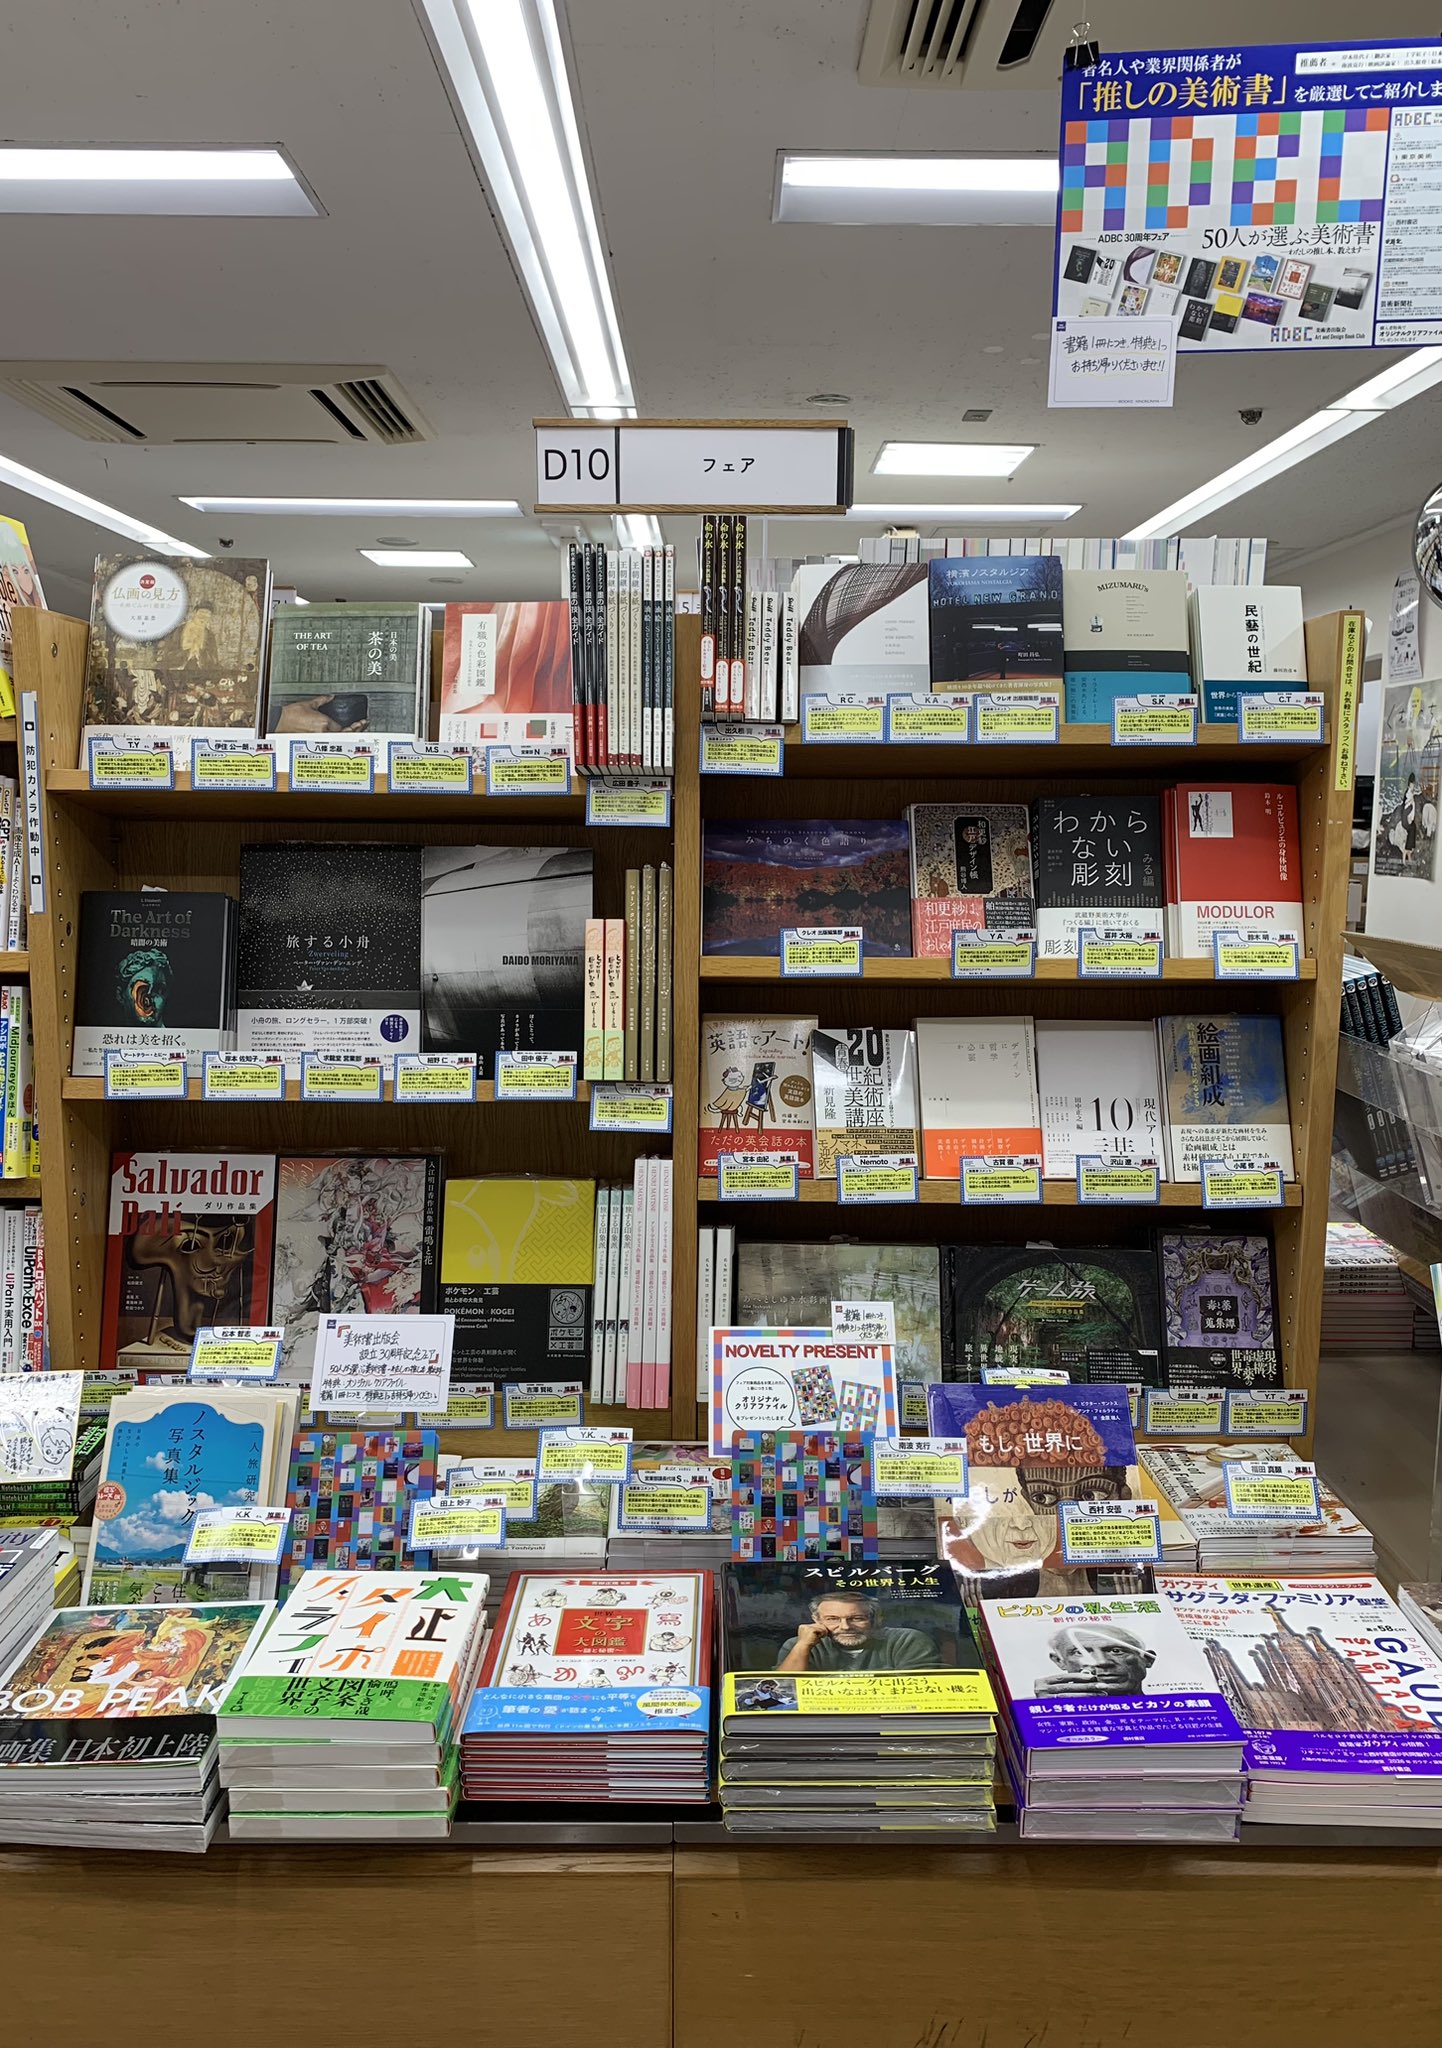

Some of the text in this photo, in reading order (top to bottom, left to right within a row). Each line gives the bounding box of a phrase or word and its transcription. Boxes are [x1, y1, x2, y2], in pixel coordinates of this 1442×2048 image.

[1077, 74, 1287, 112] 「推しの美術書」
[1098, 232, 1170, 243] ADBC 30周年フェア
[1202, 222, 1376, 249] 50人が選ぶ美術書
[1271, 327, 1313, 342] ADBC
[544, 448, 610, 480] D10
[703, 457, 756, 474] フェア
[704, 522, 713, 549] 命の水
[720, 522, 729, 549] 命の水
[736, 522, 744, 549] 命の水
[946, 567, 1029, 579] 横濱ノスタルジア
[112, 587, 181, 601] 仏画の見方
[1097, 581, 1149, 593] MIZUMARU's
[933, 590, 1058, 607] HOTEL NEW GRAND
[294, 632, 332, 640] THE ART
[748, 618, 756, 665] Teddy Bear
[763, 618, 772, 665] Teddy Bear
[785, 618, 794, 665] Teddy Bear
[1245, 604, 1262, 673] 民藝の世紀
[296, 643, 328, 651] OF TEA
[367, 631, 384, 676] 茶の美
[389, 631, 398, 662] 日本の美
[475, 620, 487, 688] 有職の色彩図鑑
[1339, 620, 1356, 789] 在庫などのお問合せは、お気軽にスタッフへお尋ね下さい。
[127, 741, 140, 749] T.Y
[214, 743, 229, 751] 伊住
[26, 745, 40, 856] 防犯カメラ作動中
[1054, 810, 1148, 834] わから
[745, 836, 867, 846] みちのく色語り
[1071, 836, 1131, 859] ない
[967, 826, 979, 880] 江戸デザイン帳
[1071, 862, 1132, 887] 彫刻
[1142, 853, 1154, 887] みる編
[110, 910, 193, 924] The Art of
[924, 901, 981, 916] 和更紗は、
[1197, 906, 1275, 918] MODULOR
[110, 924, 191, 939] Darkness
[130, 939, 168, 947] 暗闇の美術
[286, 935, 370, 950] 旅する小舟
[502, 955, 579, 966] DAIDO MORIYAMA
[102, 1034, 186, 1047] 恐れは美を招く。
[707, 1029, 811, 1055] 英語でアート!
[846, 1029, 884, 1066] 20
[225, 1054, 237, 1062] 岸本
[1197, 1022, 1225, 1107] 絵画組成
[846, 1066, 884, 1087] 世紀
[824, 1087, 837, 1120] 新見隆
[845, 1087, 885, 1107] 美術
[845, 1108, 885, 1128] 講座
[1090, 1097, 1134, 1131] 10
[710, 1135, 807, 1146] ただの英会話の本
[1181, 1143, 1236, 1152] 「絵画組成」とは
[122, 1159, 264, 1196] Salvador
[204, 1202, 257, 1211] ダリ作品集
[424, 1161, 436, 1266] 入江明日香作品集 雷鳴と花
[599, 1206, 607, 1249] 旅する印象派
[611, 1206, 619, 1249] 旅する印象派
[624, 1206, 632, 1249] 旅する印象派
[1017, 1279, 1097, 1300] ゲーム旅
[490, 1307, 515, 1315] KOGEI
[1206, 1300, 1232, 1311] 毒と薬
[1205, 1318, 1236, 1329] 蒐集譚
[550, 1328, 583, 1337] ポケモン
[725, 1344, 878, 1359] NOVELTY PRESENT
[964, 1343, 973, 1371] 旅する
[1231, 1350, 1243, 1379] 世界へ
[735, 1402, 788, 1410] クリアファイル
[742, 1395, 780, 1403] オリジナル
[581, 1431, 596, 1439] Y.K.
[979, 1432, 1083, 1453] もし、世界に
[899, 1442, 930, 1450] 南波 克行
[163, 1428, 185, 1485] 写真集
[181, 1410, 206, 1526] ノスタルジック
[440, 1500, 455, 1508] 田上
[1089, 1505, 1104, 1514] 西村
[235, 1511, 251, 1519] K.K
[804, 1564, 941, 1578] スピルバーグ
[835, 1577, 941, 1587] その世界と人生
[1159, 1580, 1218, 1591] ガウディ
[1165, 1591, 1355, 1606] サグラダ・ファミリア
[405, 1577, 474, 1642] 大正
[998, 1600, 1162, 1618] ピカソの私生活
[1173, 1606, 1254, 1615] ガウディが心に描いた
[528, 1613, 552, 1627] あ
[572, 1616, 634, 1631] 文字
[1053, 1615, 1112, 1623] 創作の秘密
[319, 1587, 415, 1673] タイポ
[573, 1637, 627, 1647] 大図鑑
[800, 1678, 938, 1688] スピルバーグに出会う、
[801, 1685, 978, 1696] 出会いなおす、またとない機会
[1353, 1638, 1433, 1729] SAGRADA
[98, 1683, 232, 1712] PEAK
[280, 1677, 307, 1709] 世界。
[304, 1677, 333, 1715] 文字の
[501, 1704, 622, 1715] 筆者の愛が詰まった本。
[1029, 1700, 1212, 1714] 親しき者だけが知るピカソの素顔
[60, 1734, 210, 1762] 日本初上陸
